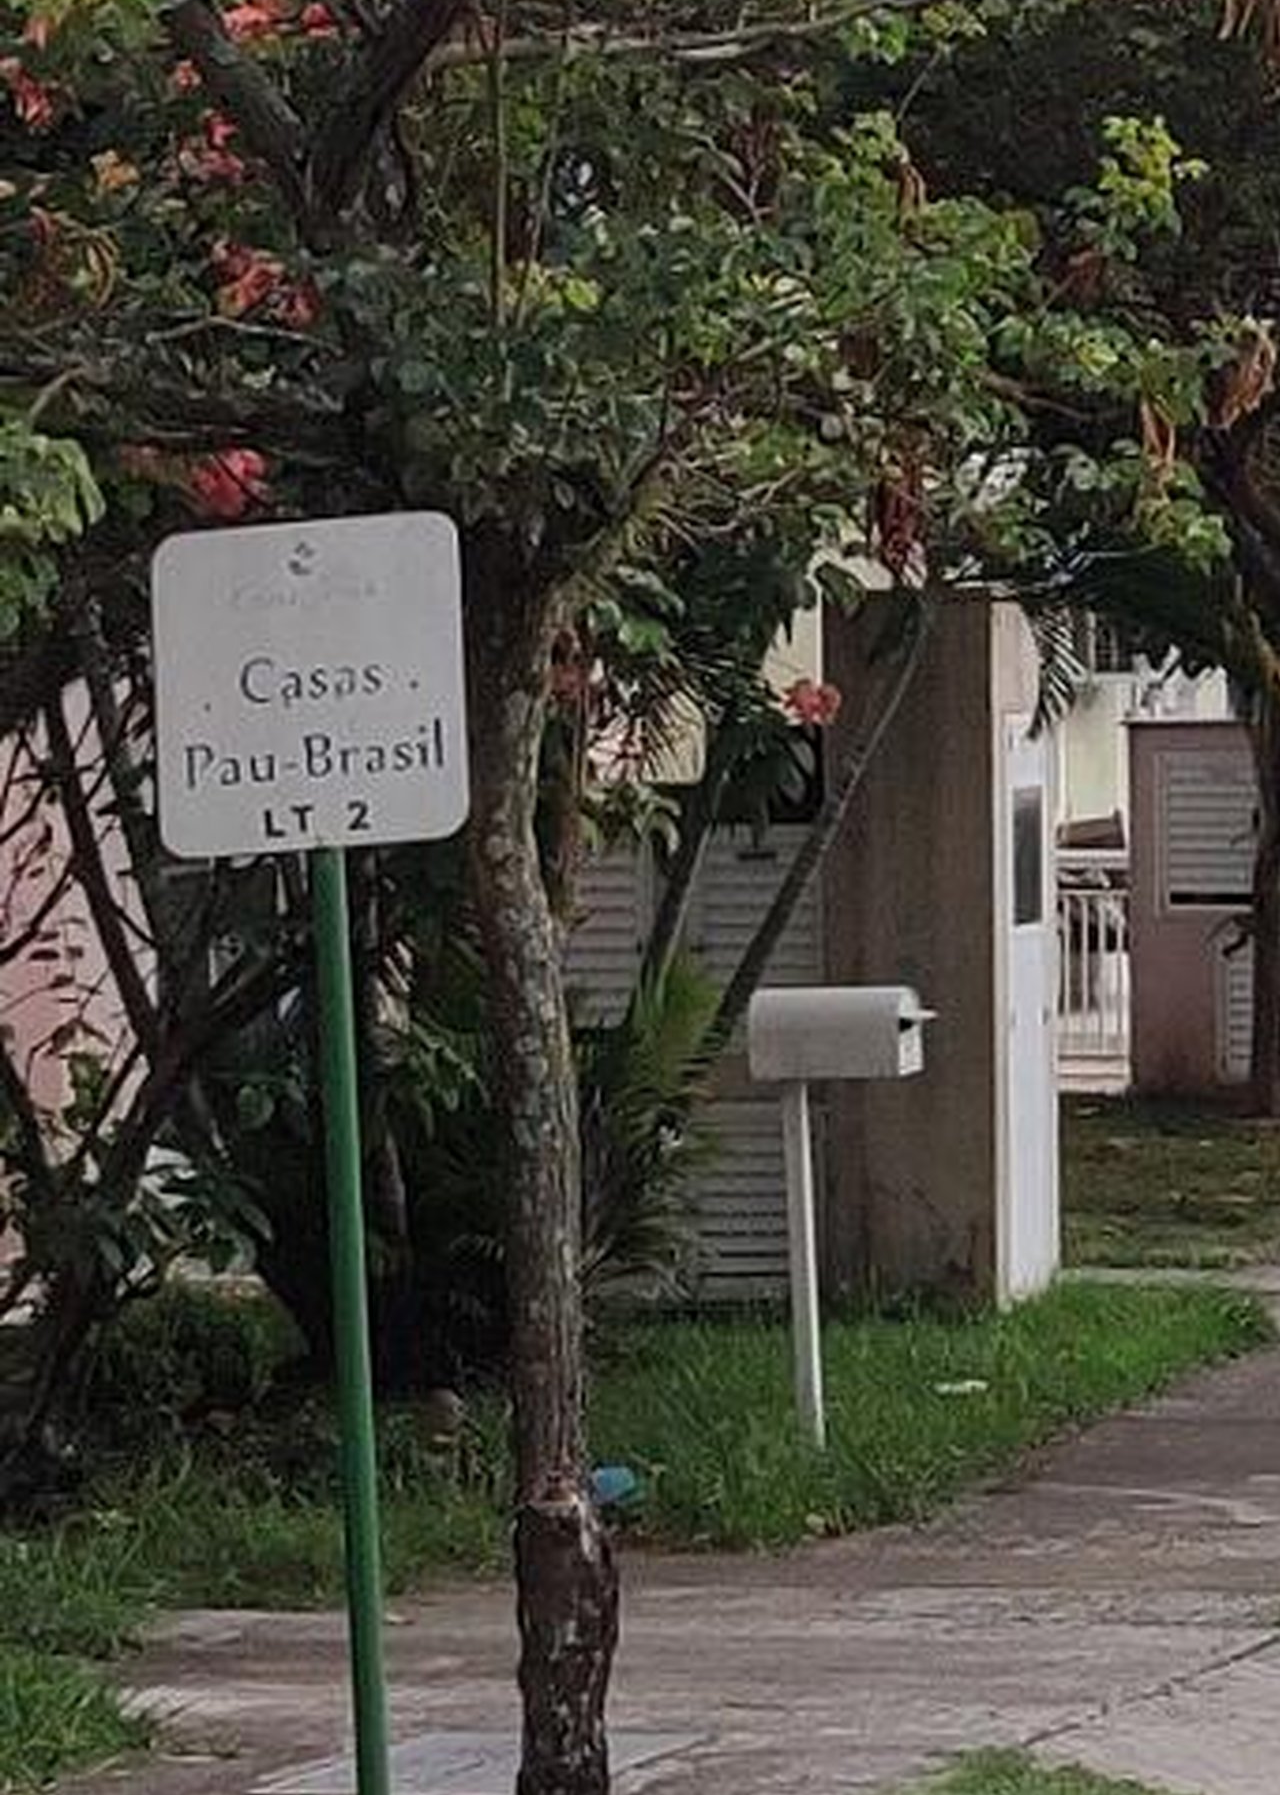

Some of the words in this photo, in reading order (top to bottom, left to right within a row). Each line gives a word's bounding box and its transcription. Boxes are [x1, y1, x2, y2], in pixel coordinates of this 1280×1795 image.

[238, 655, 385, 706] Casas
[184, 716, 446, 791] Pau-Brasil
[262, 803, 315, 838] LT
[346, 799, 373, 832] 2
